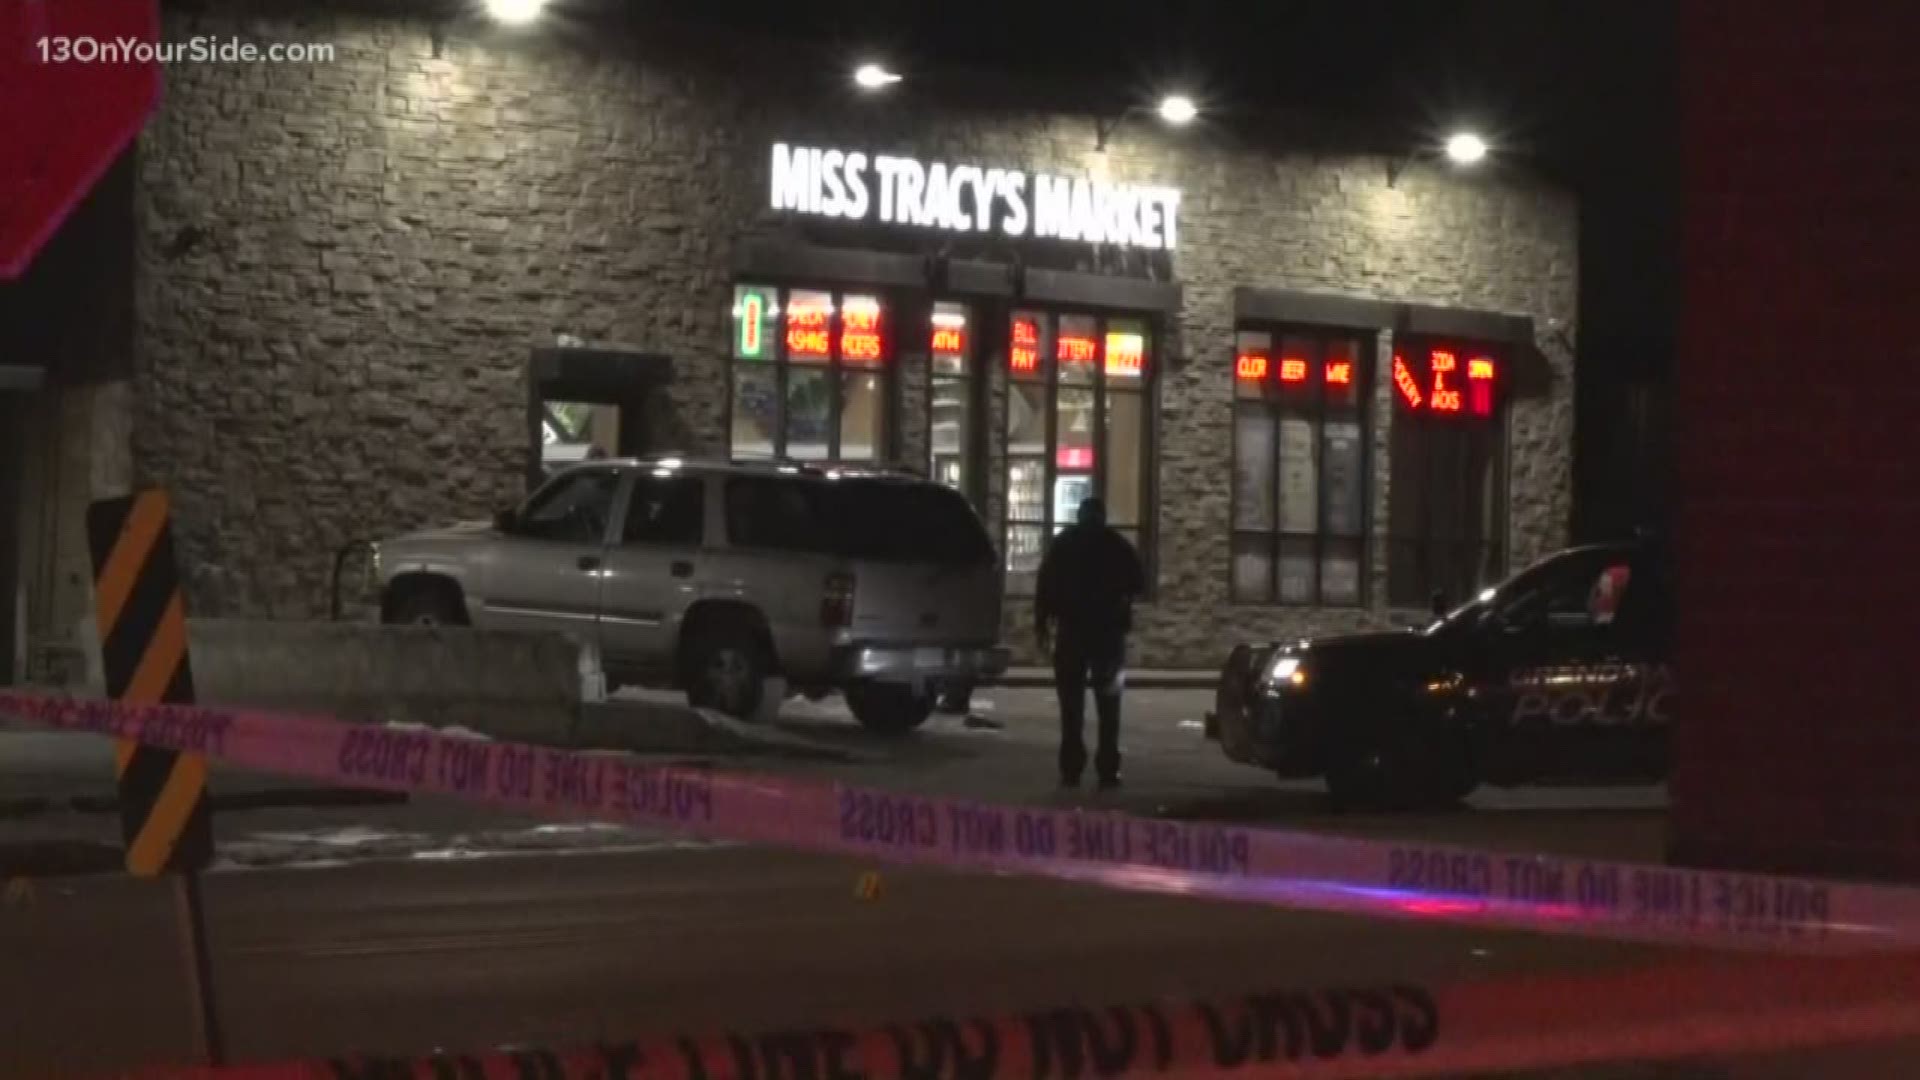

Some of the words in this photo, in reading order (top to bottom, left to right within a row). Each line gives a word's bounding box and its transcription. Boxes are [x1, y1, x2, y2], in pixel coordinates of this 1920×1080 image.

[770, 143, 869, 219] MISS
[874, 155, 1028, 236] TRACY'S
[1033, 174, 1181, 250] MARKET
[932, 331, 961, 351] ATM
[1010, 347, 1036, 371] PAY
[1510, 692, 1670, 725] POLIC
[1196, 985, 1440, 1068] CROSS
